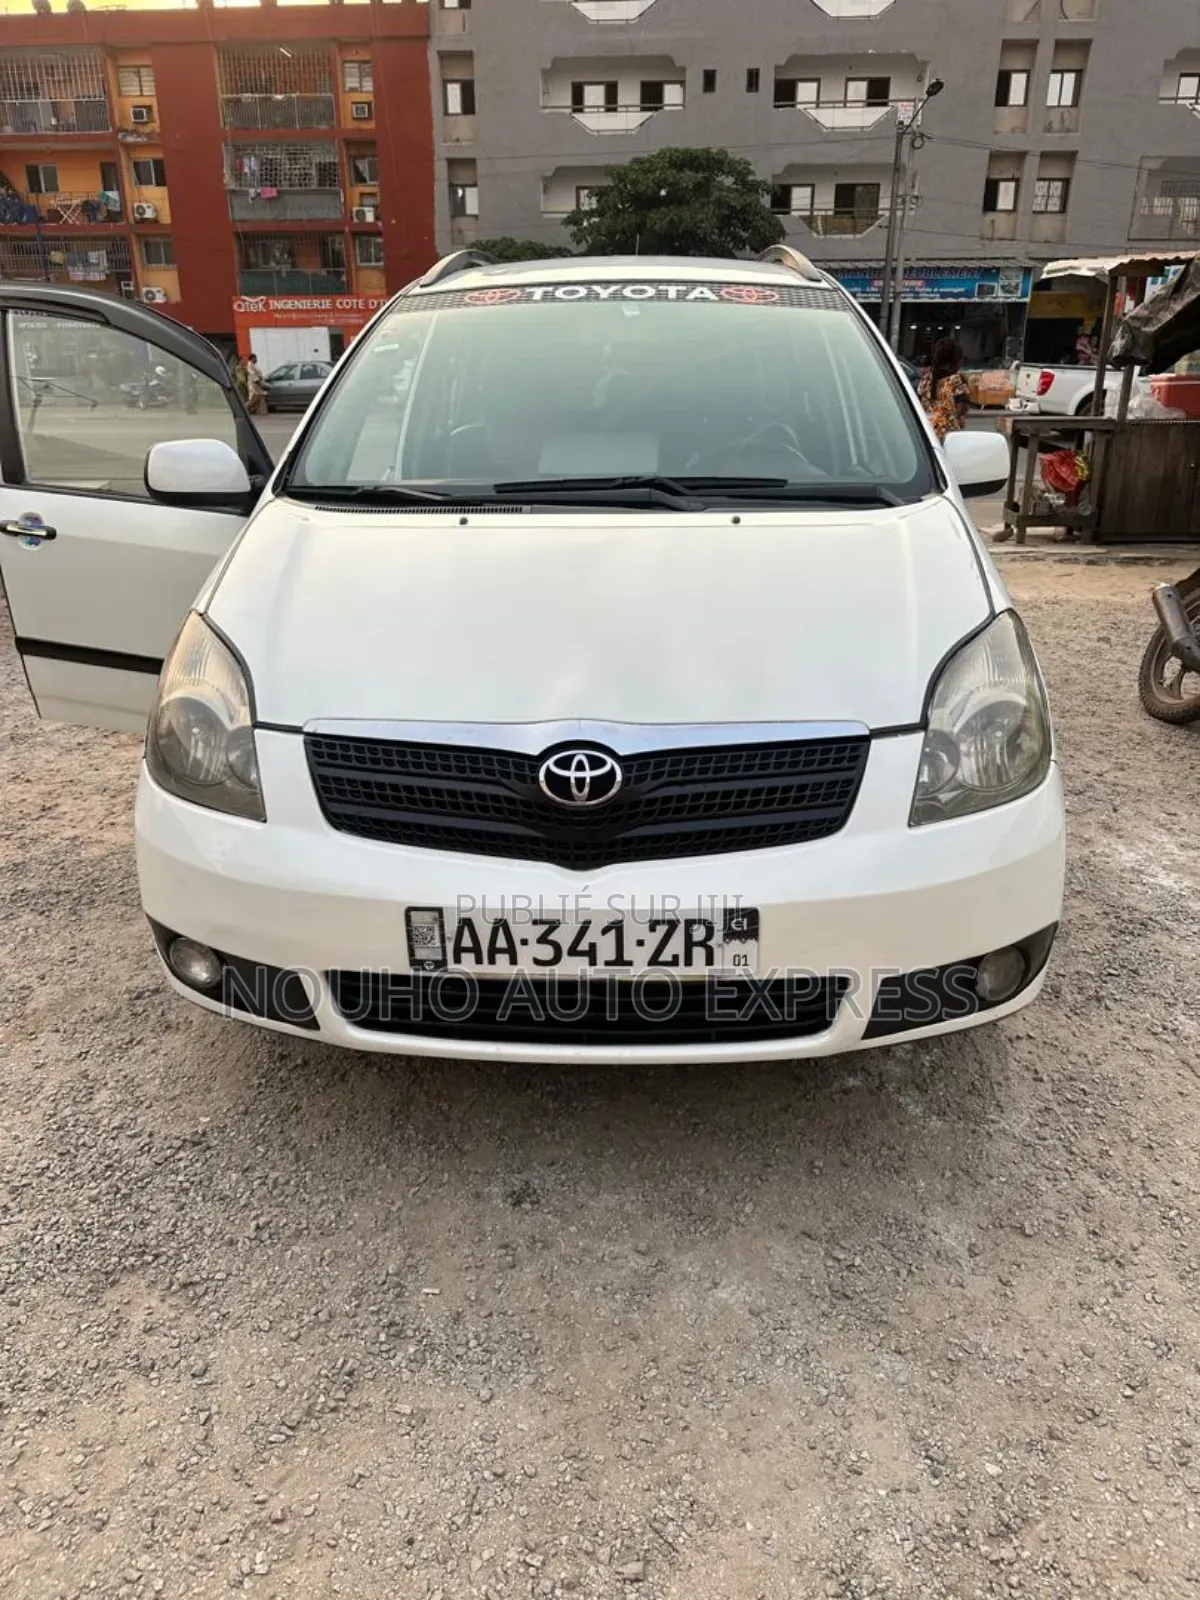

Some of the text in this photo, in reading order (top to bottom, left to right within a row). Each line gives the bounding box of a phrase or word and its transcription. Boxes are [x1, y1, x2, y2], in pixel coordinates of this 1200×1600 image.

[524, 285, 719, 301] TOYOTA
[269, 299, 332, 310] INGENIERIE
[336, 299, 365, 309] COTE
[733, 953, 749, 967] 01
